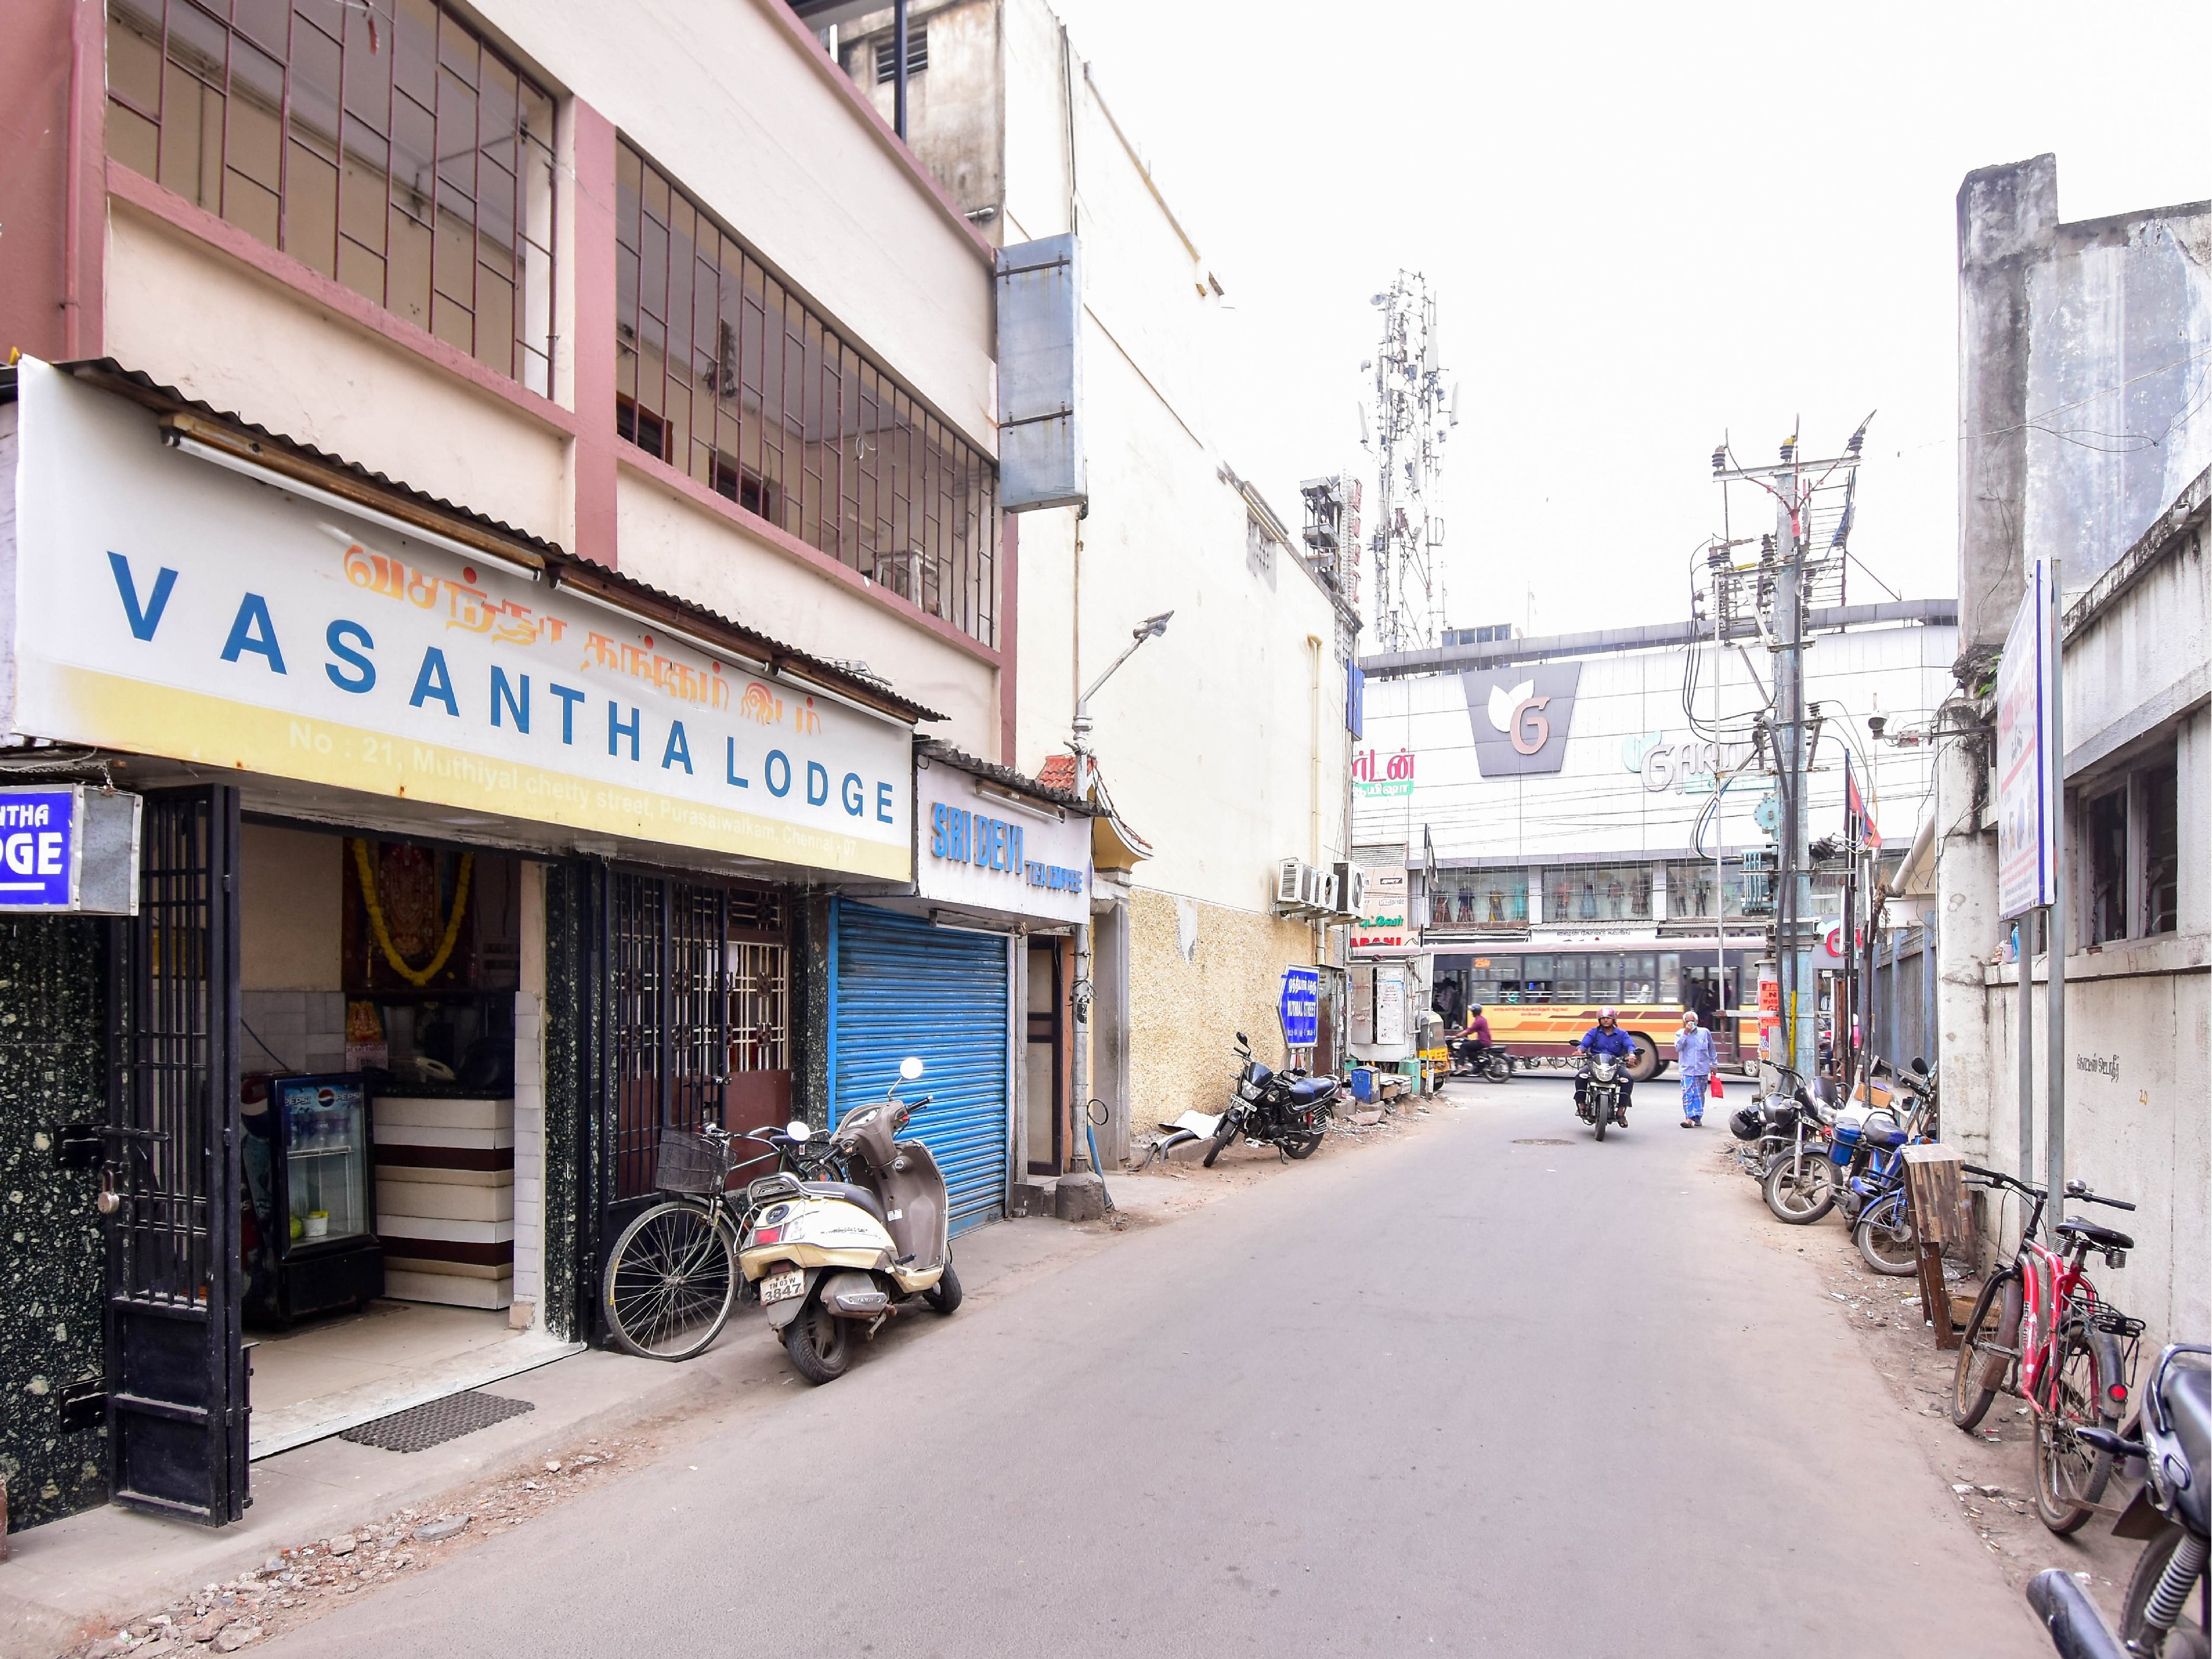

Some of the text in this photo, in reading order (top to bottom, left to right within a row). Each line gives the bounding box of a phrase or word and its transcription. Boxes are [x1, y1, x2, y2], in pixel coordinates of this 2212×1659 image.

[107, 550, 893, 824] VASANTHA LODGE
[289, 720, 332, 754] No
[362, 737, 402, 772] 21,
[413, 745, 518, 792] Muthiyal
[526, 773, 590, 808] chetty
[0, 832, 63, 875] GE
[931, 802, 1023, 875] SRI DEVI
[1025, 860, 1083, 893] TEA COFFEE
[1304, 1001, 1317, 1017] STREET
[284, 1096, 311, 1107] PEPSI
[335, 1092, 361, 1102] PEPSI
[765, 1283, 801, 1301] 3847
